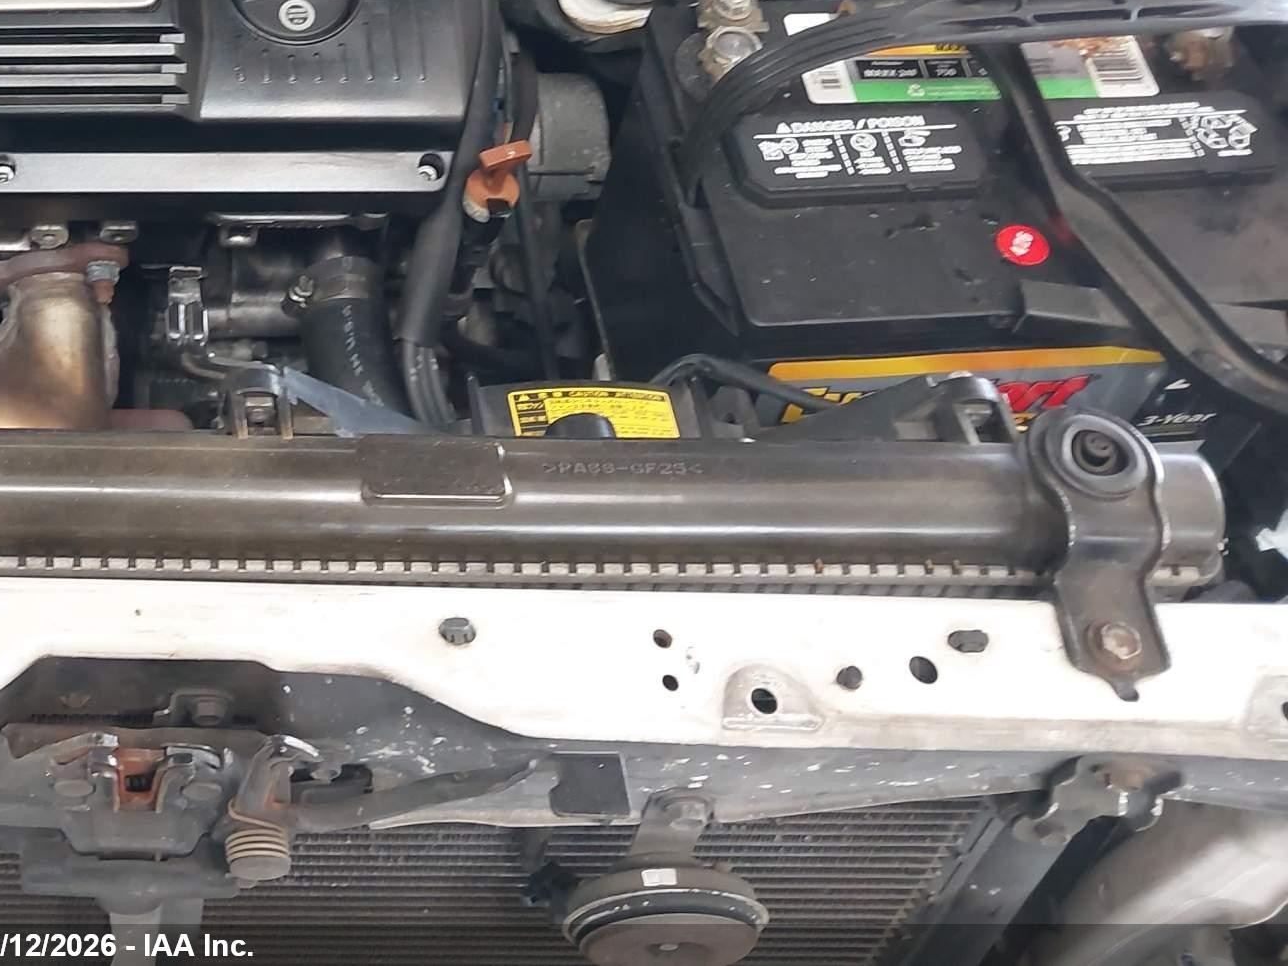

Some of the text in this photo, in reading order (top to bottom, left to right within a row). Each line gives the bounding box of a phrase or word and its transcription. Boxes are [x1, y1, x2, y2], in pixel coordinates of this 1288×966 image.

[790, 119, 855, 133] DANGER
[867, 115, 926, 129] POISON
[1137, 409, 1216, 427] 3-Year
